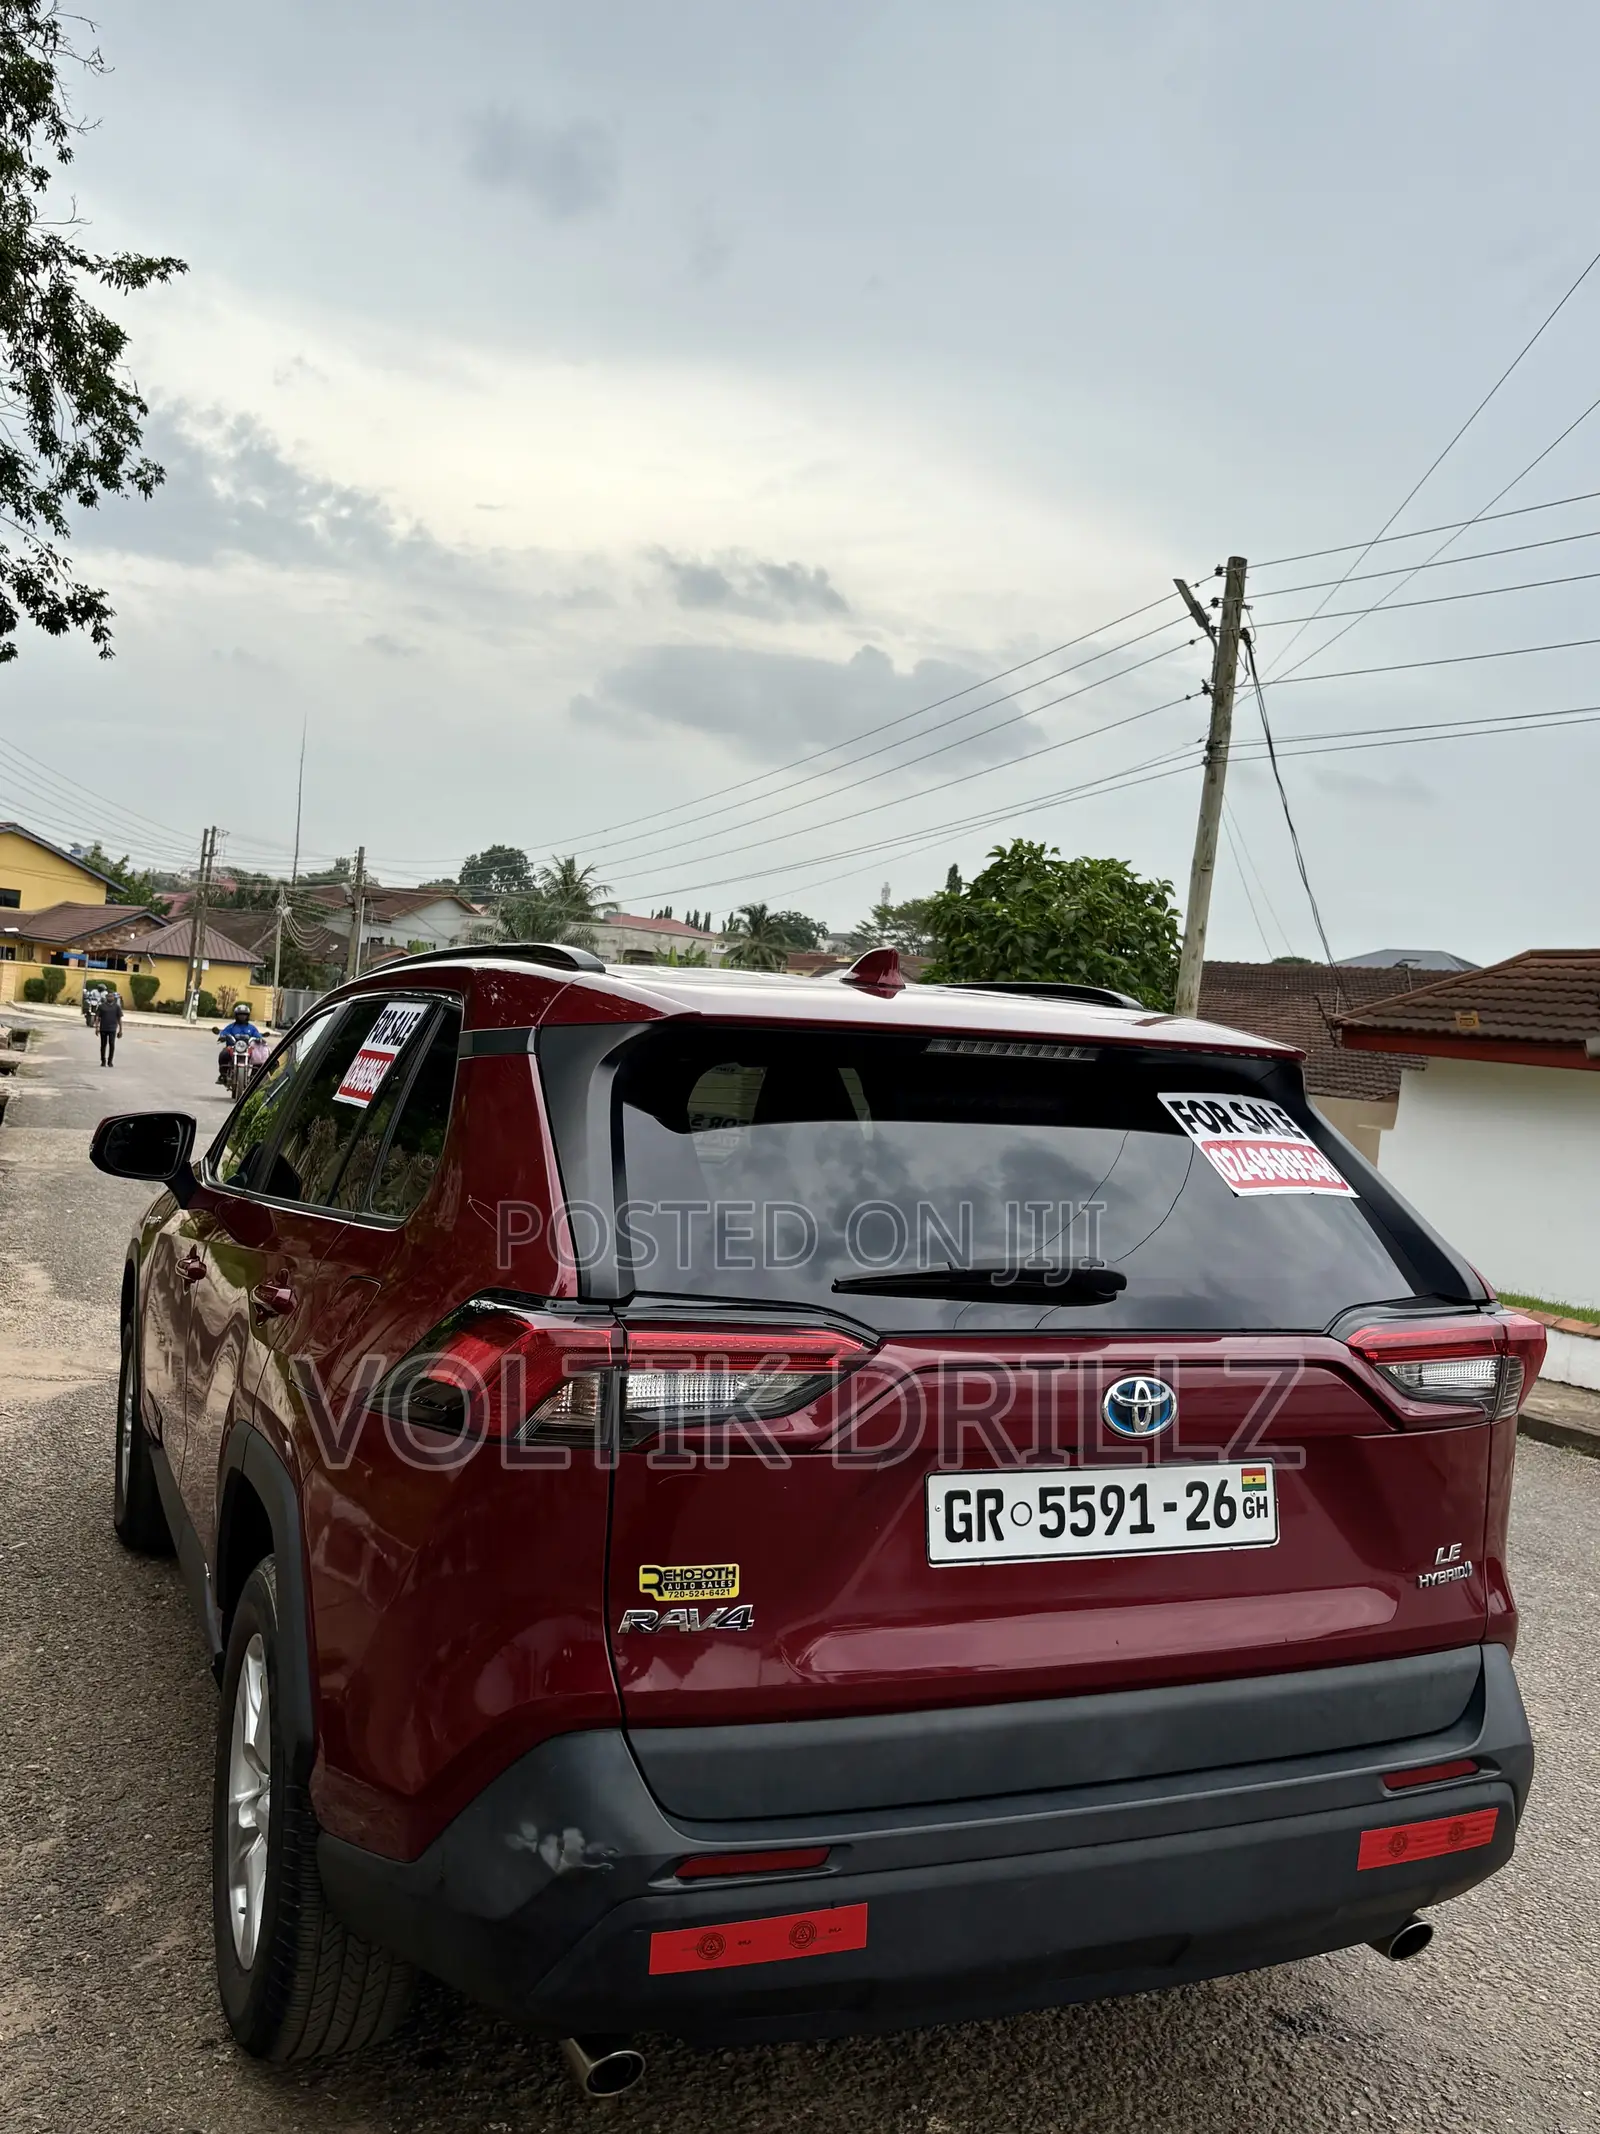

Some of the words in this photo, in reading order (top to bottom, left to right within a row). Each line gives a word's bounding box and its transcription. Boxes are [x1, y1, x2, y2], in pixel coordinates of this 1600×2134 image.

[367, 1010, 398, 1044] FOR
[383, 1010, 422, 1047] SALE
[1167, 1100, 1242, 1134] FOR
[1229, 1101, 1307, 1140] SALE
[944, 1488, 1005, 1543] GR
[1242, 1496, 1268, 1519] GH
[1434, 1543, 1462, 1565] LE
[641, 1565, 737, 1597] REHOBOTH
[667, 1582, 696, 1590] AUTO
[701, 1579, 733, 1588] SALES
[1418, 1565, 1466, 1588] HYBRID
[668, 1588, 731, 1599] 720-524-6421
[617, 1604, 755, 1633] RAV4
